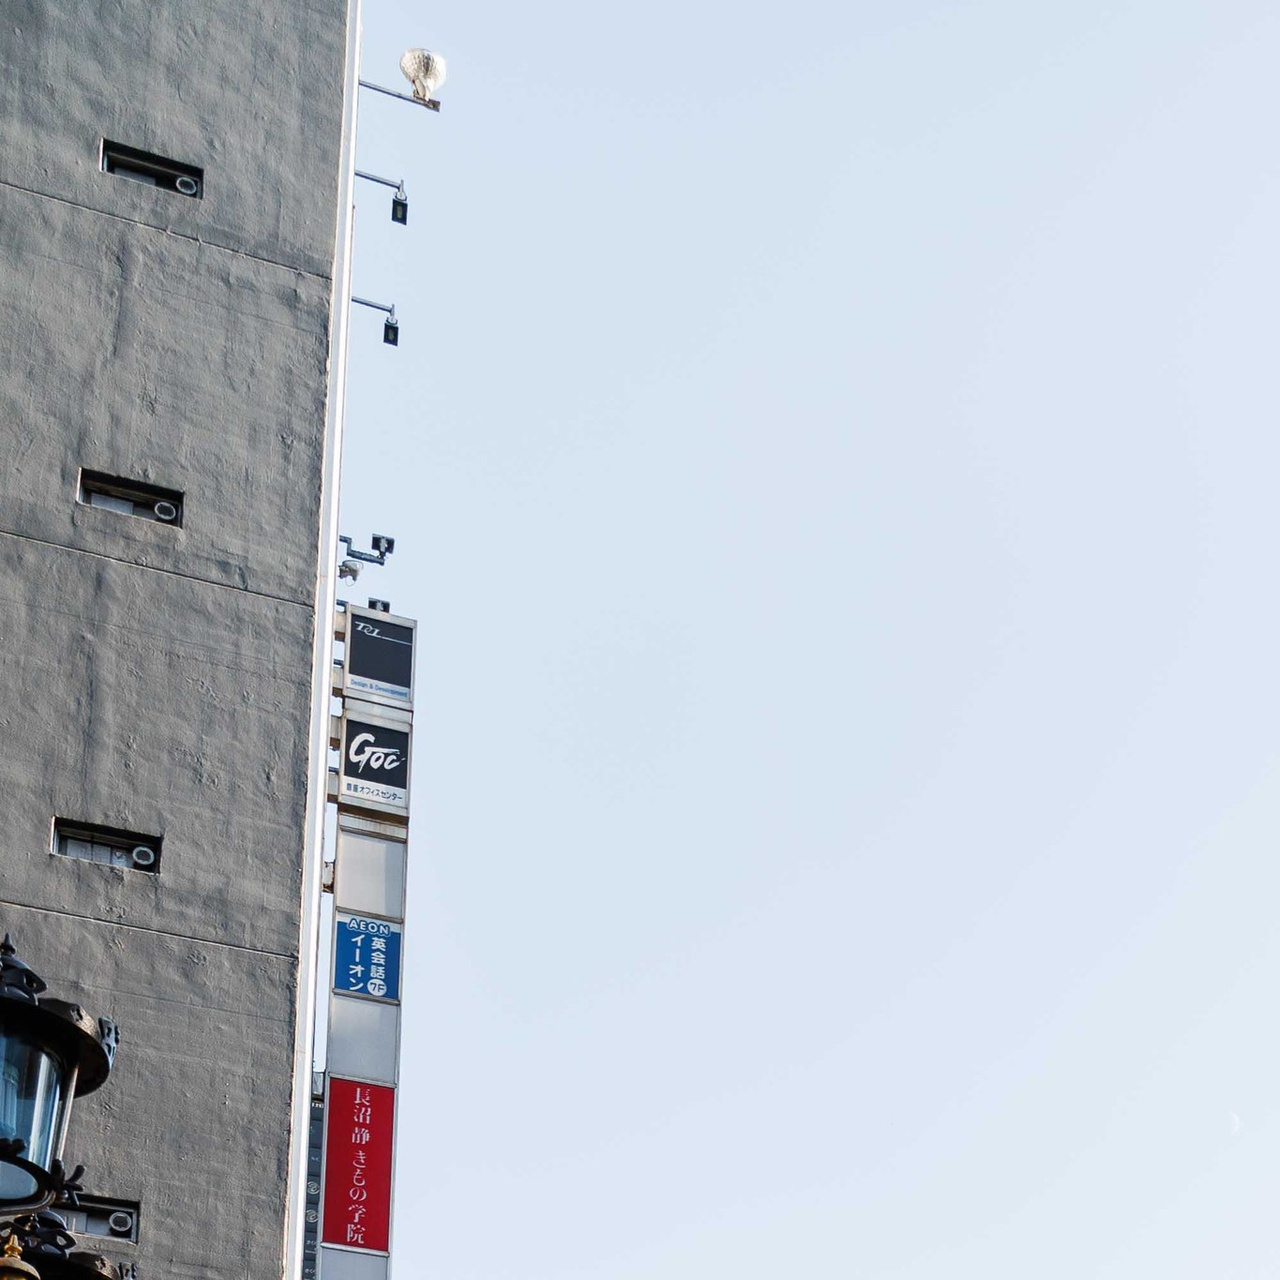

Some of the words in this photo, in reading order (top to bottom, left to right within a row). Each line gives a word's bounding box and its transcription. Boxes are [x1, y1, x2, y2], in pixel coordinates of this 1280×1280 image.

[349, 919, 390, 935] AEON
[349, 934, 365, 990] イーオン
[370, 937, 386, 979] 英会話
[370, 982, 386, 993] 7F
